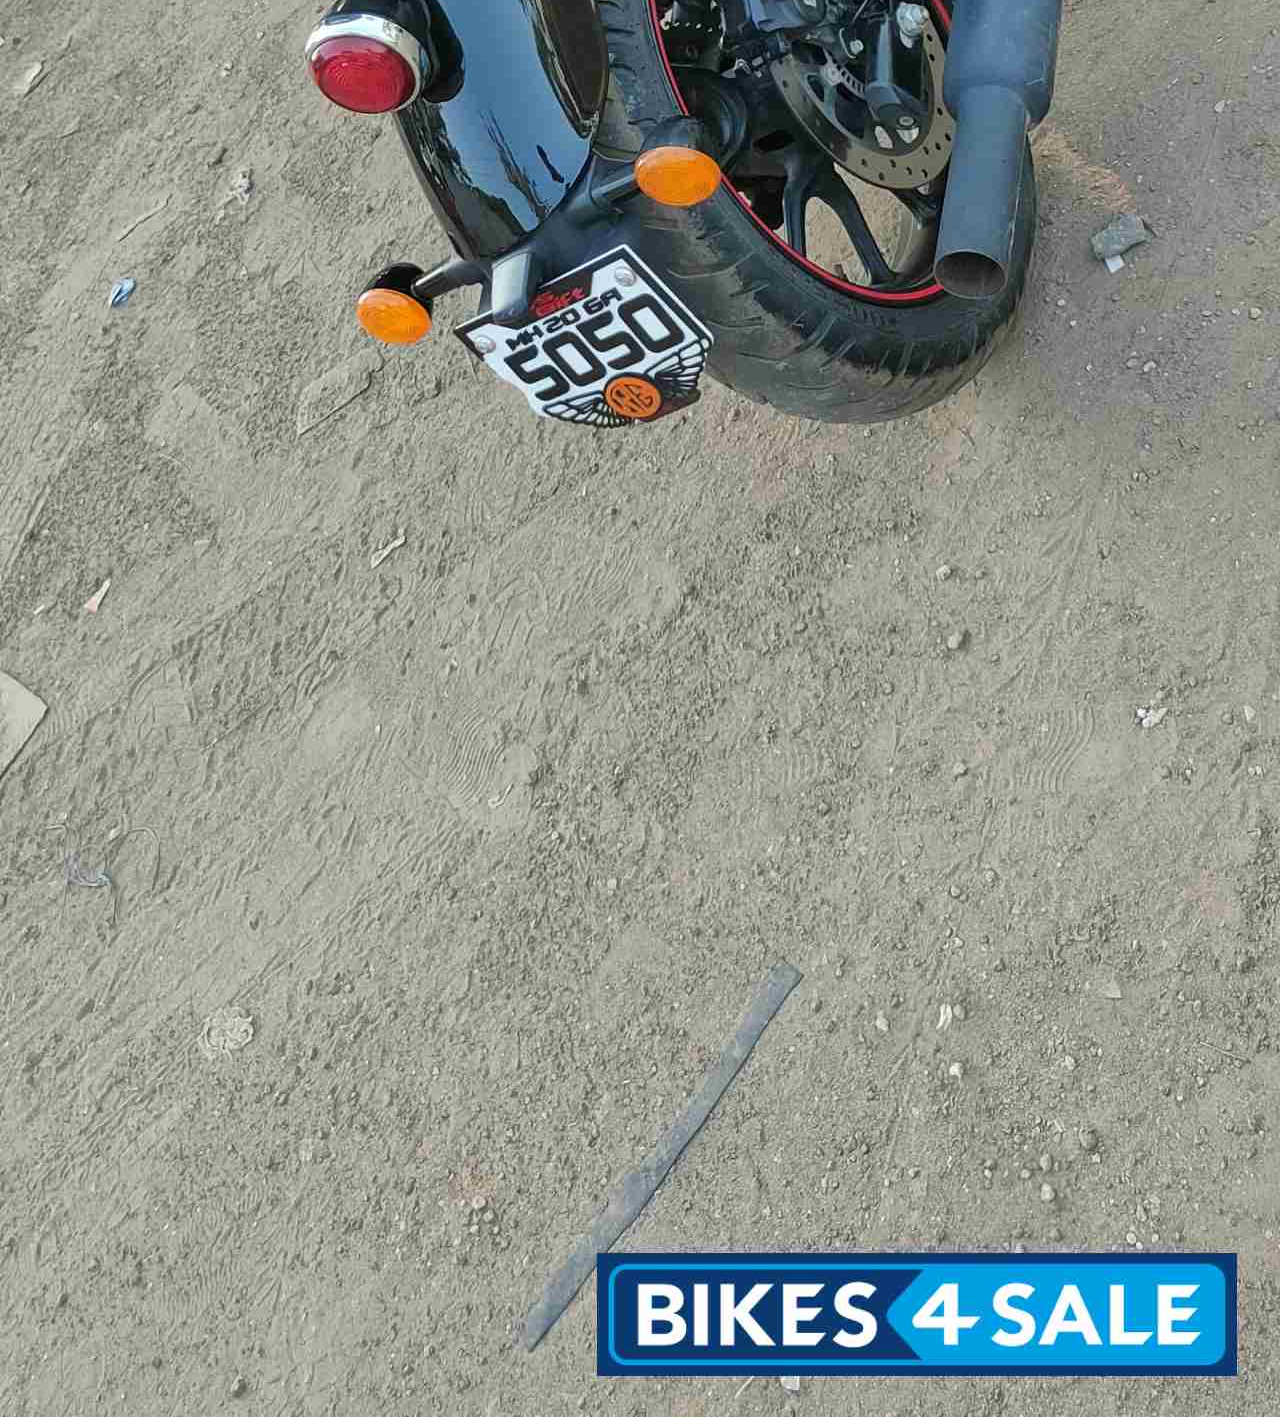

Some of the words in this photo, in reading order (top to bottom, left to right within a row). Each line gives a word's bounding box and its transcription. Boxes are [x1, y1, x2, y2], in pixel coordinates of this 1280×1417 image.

[503, 293, 684, 401] 5050
[505, 325, 544, 351] MH
[544, 309, 580, 333] 20
